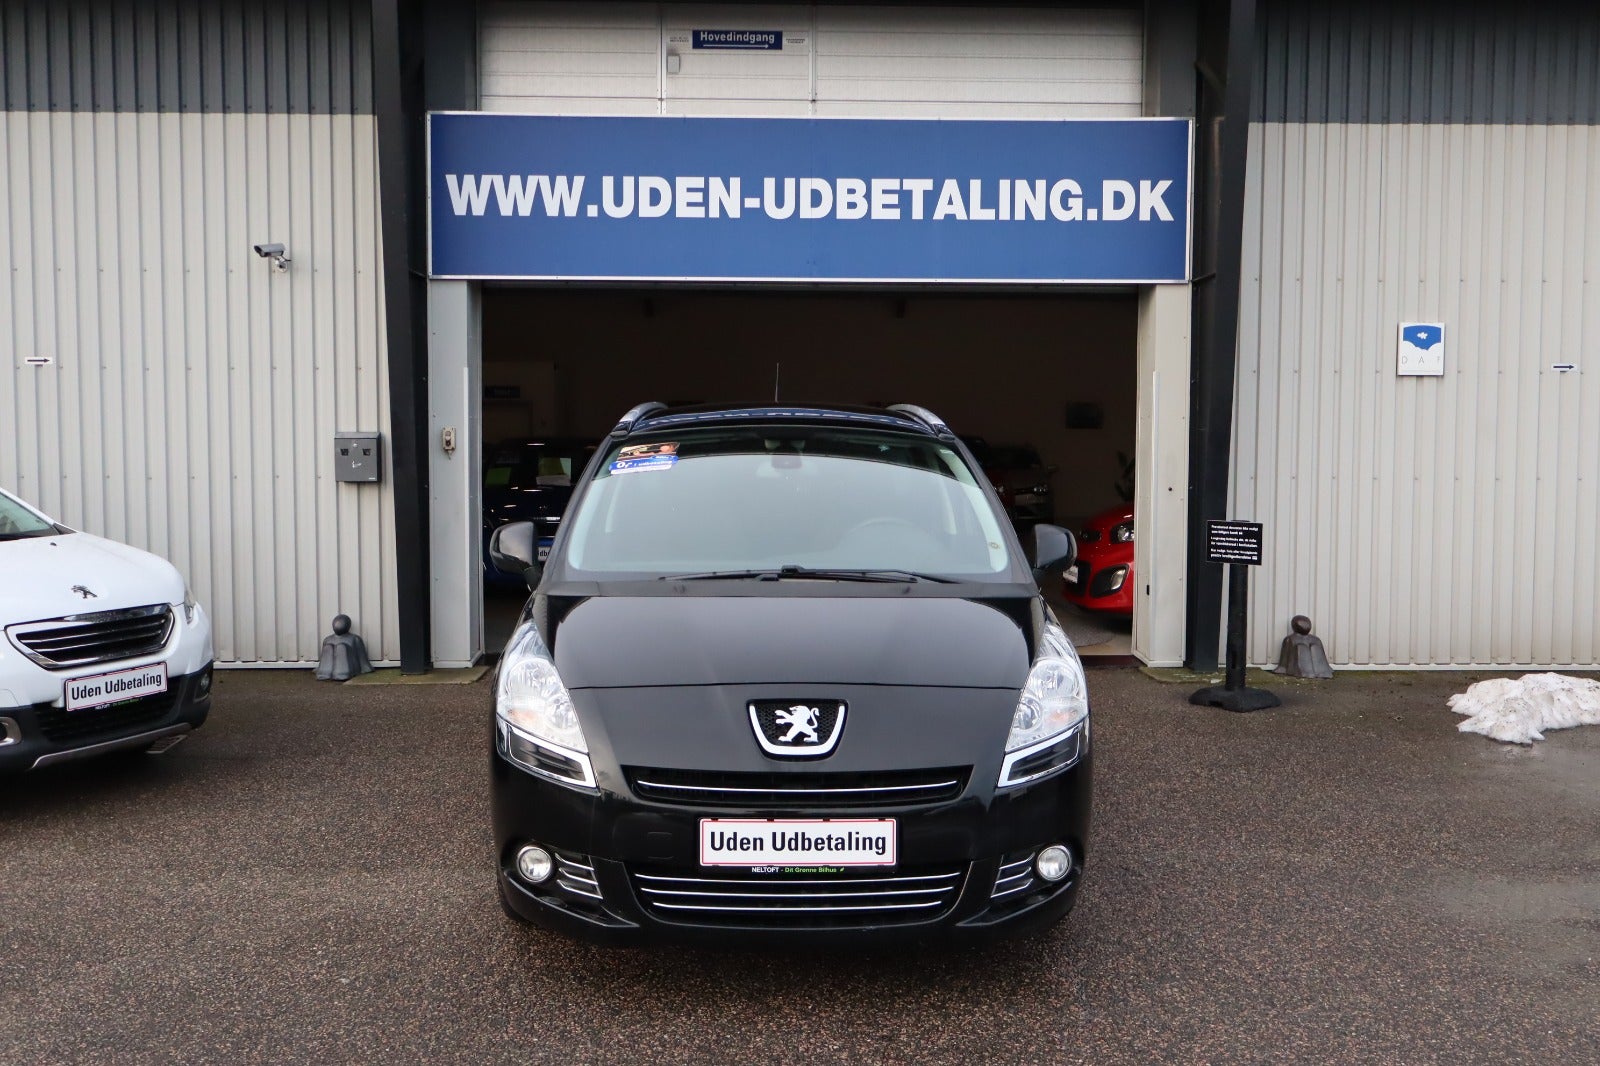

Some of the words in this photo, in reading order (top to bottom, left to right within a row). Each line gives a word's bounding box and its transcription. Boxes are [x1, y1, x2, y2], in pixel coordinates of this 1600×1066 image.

[701, 31, 775, 43] Hovedindgang
[446, 174, 1174, 222] WWW.UDEN-UDBETALING.DK
[72, 685, 101, 701] Uden
[105, 673, 162, 694] Udbetaling
[711, 831, 764, 852] Uden
[771, 831, 886, 856] Udbetaling
